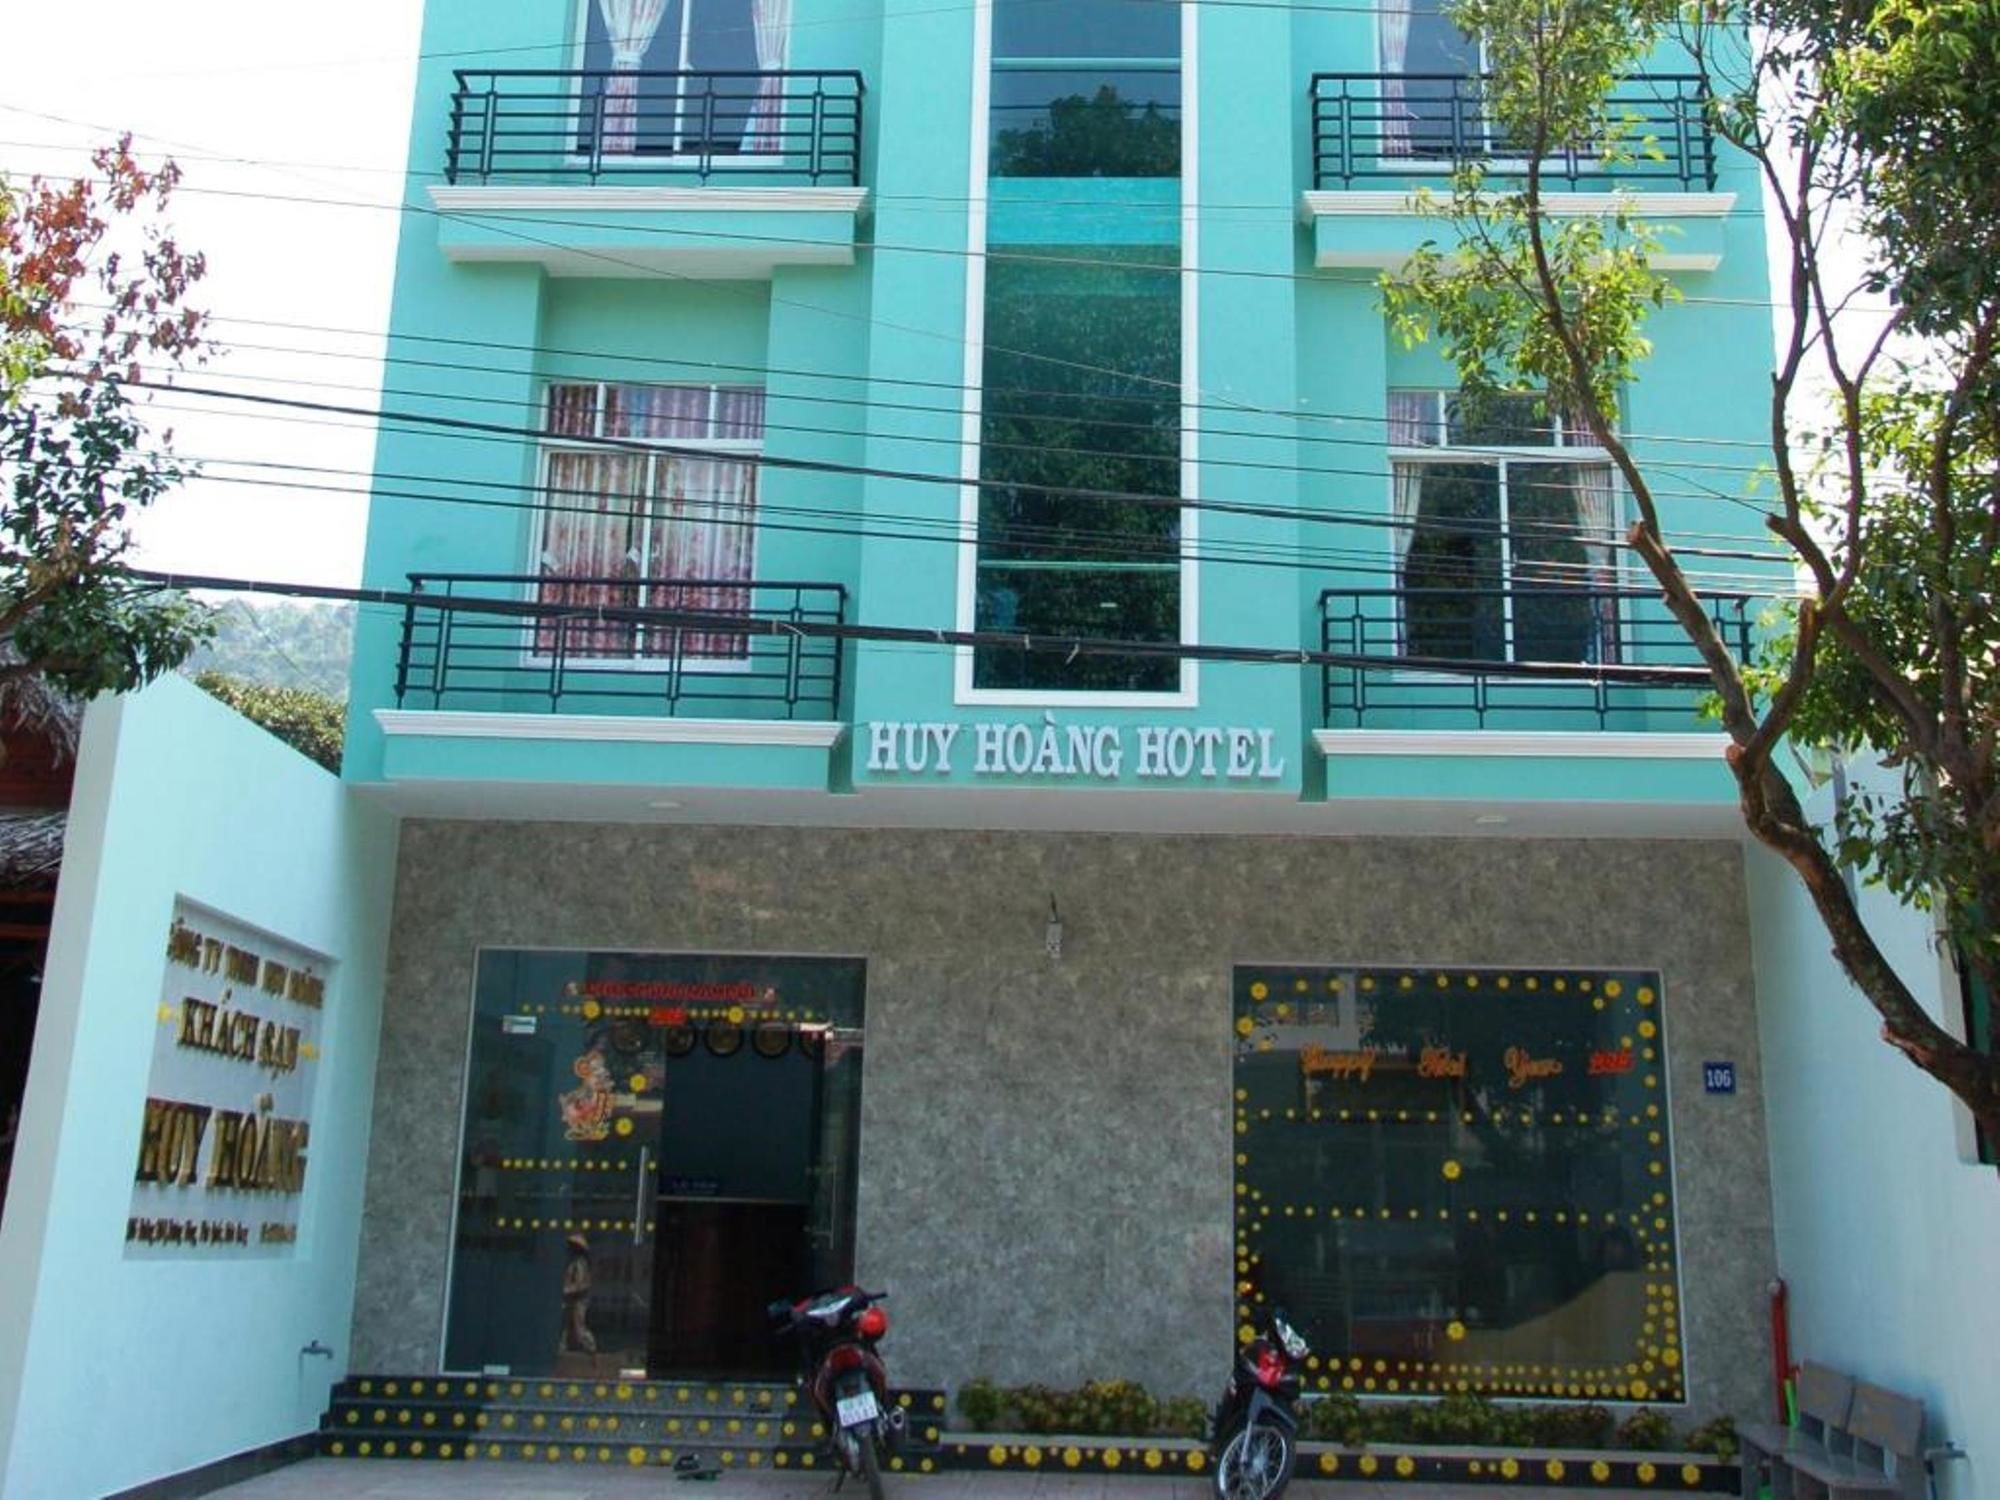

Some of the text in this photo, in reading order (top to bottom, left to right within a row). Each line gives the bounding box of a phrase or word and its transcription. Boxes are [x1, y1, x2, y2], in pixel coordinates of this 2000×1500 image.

[867, 710, 1286, 780] HUY HOÀNG HOTEL
[177, 988, 260, 1061] KHÁCH
[1707, 1069, 1732, 1088] 106
[133, 1096, 213, 1185] HUY
